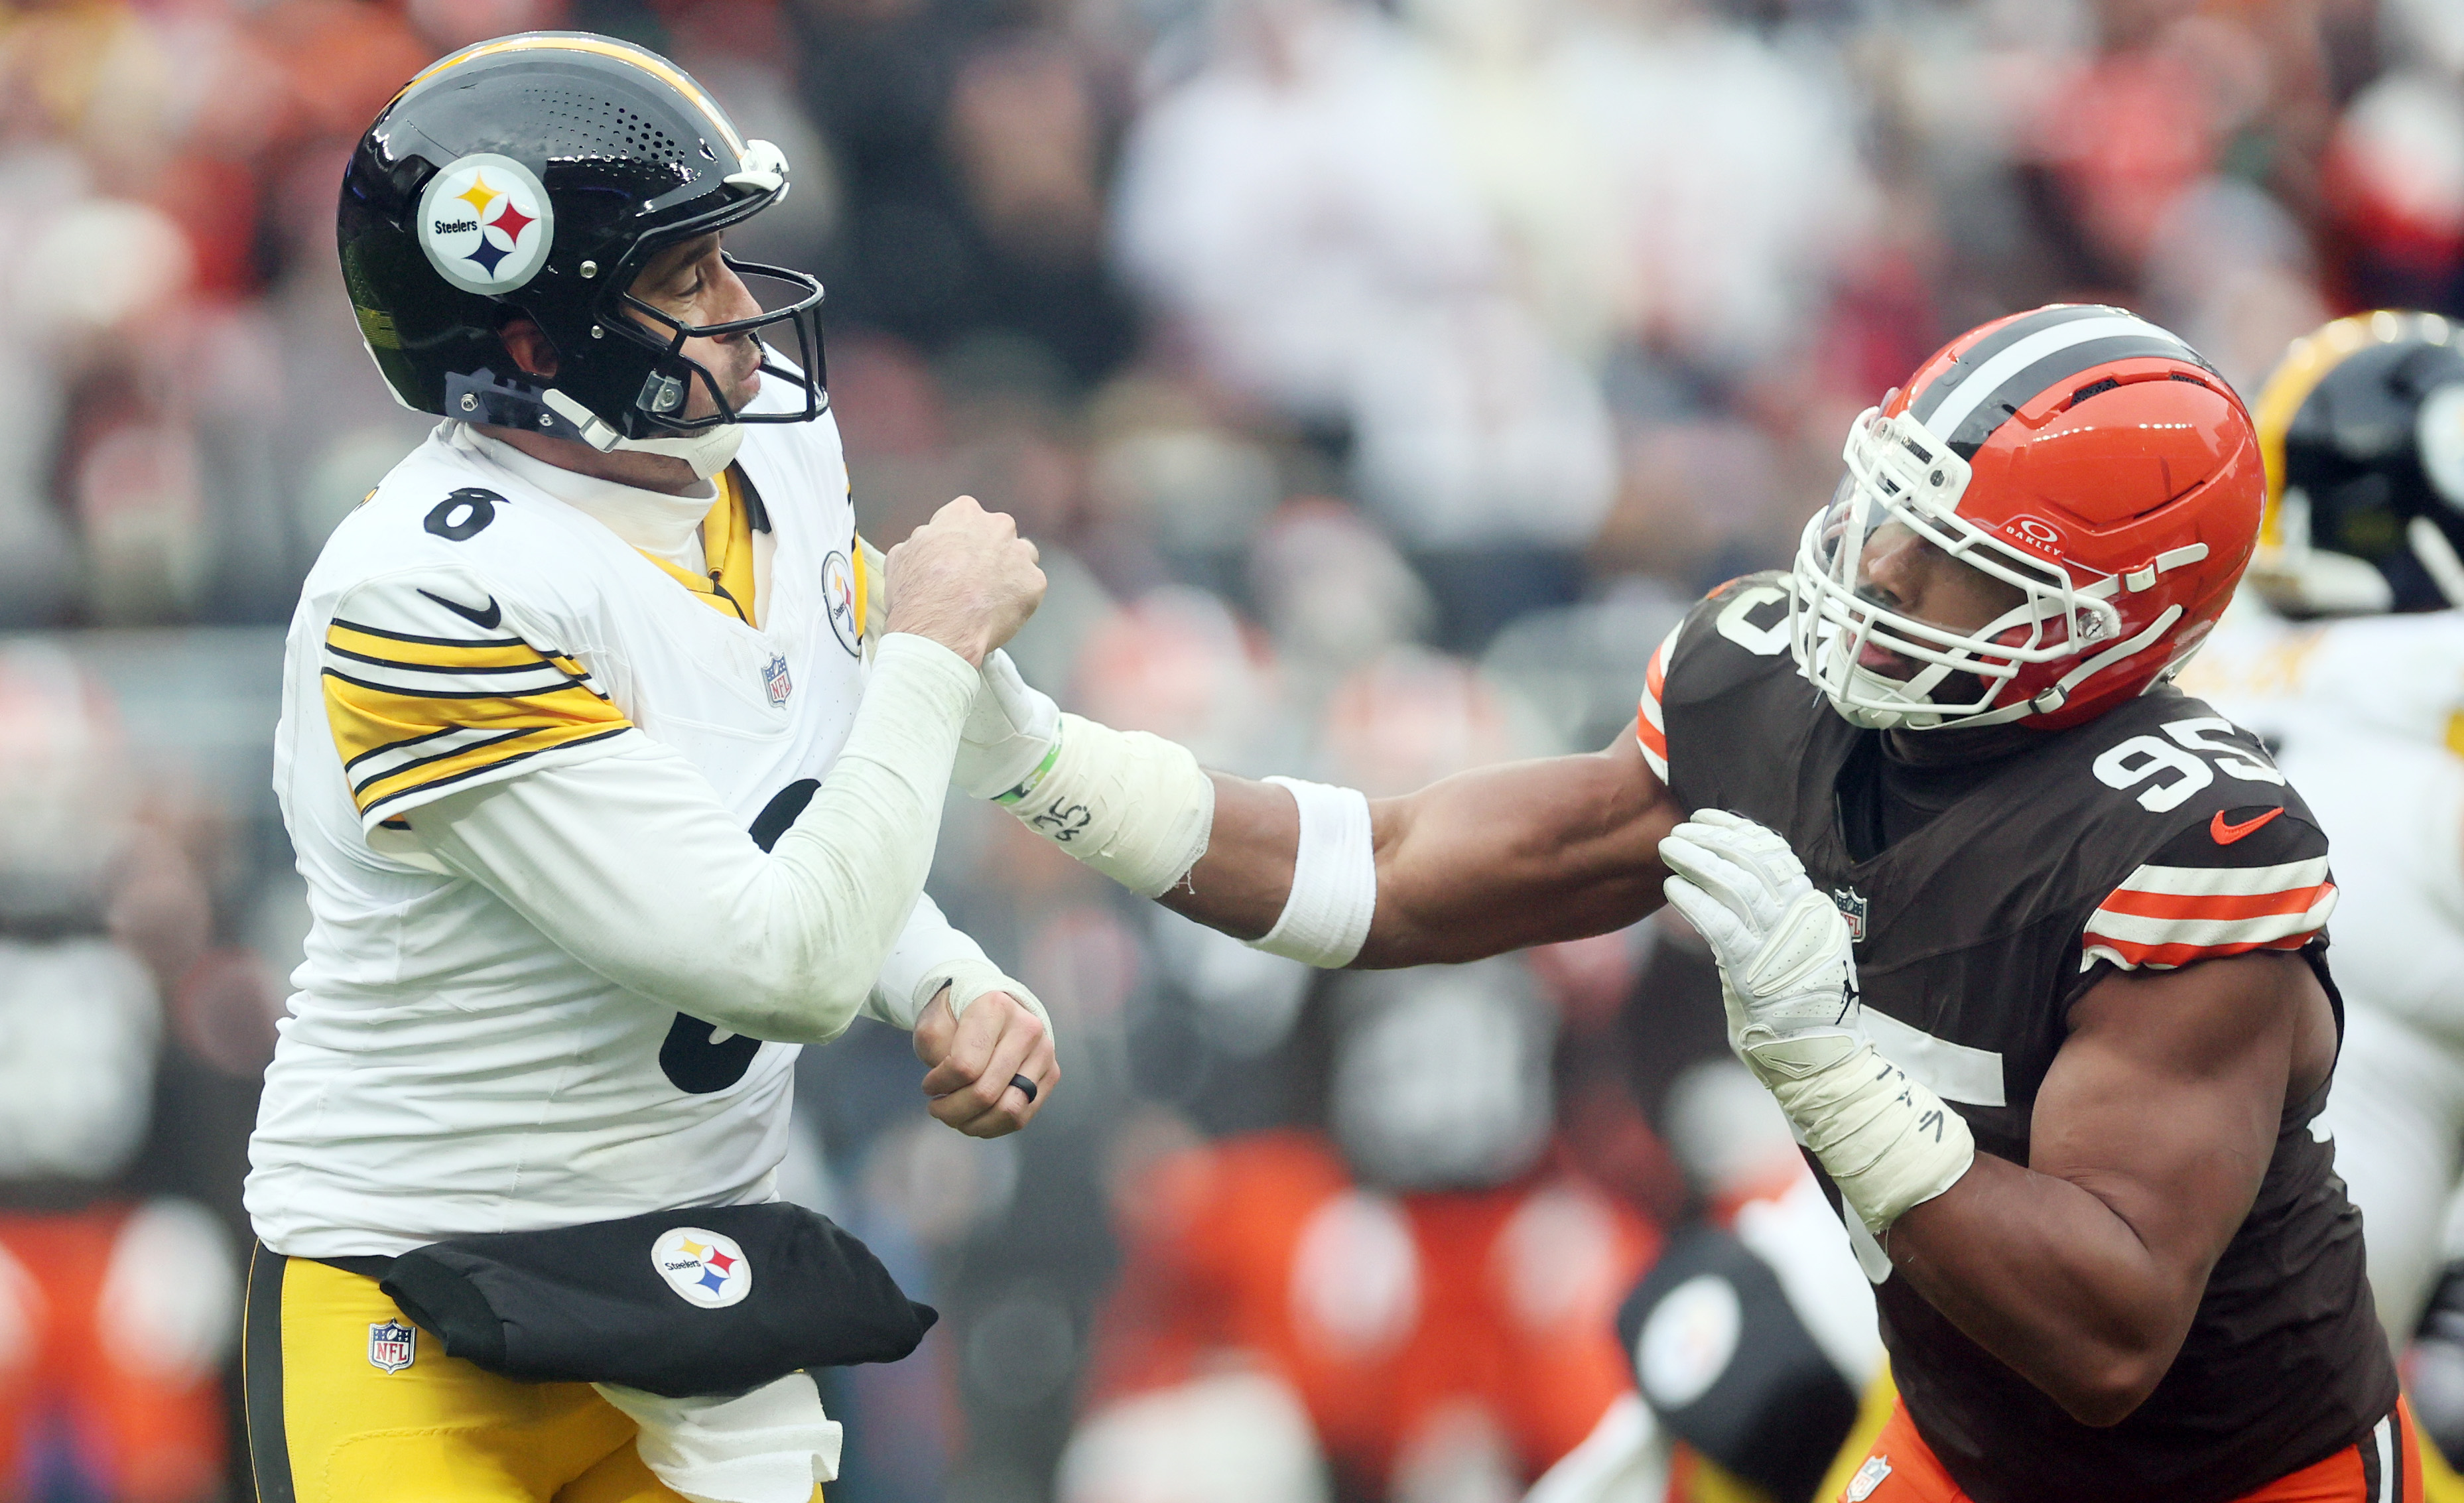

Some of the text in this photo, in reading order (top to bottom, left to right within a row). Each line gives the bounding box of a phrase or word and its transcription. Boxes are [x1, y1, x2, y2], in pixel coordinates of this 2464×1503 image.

[435, 220, 478, 234] Steelers
[2006, 525, 2061, 555] OAKLEY
[771, 675, 790, 700] NFL
[2092, 717, 2286, 813] 95
[1841, 913, 1860, 935] FL
[665, 1260, 701, 1270] Steelers
[376, 1342, 407, 1363] NFL
